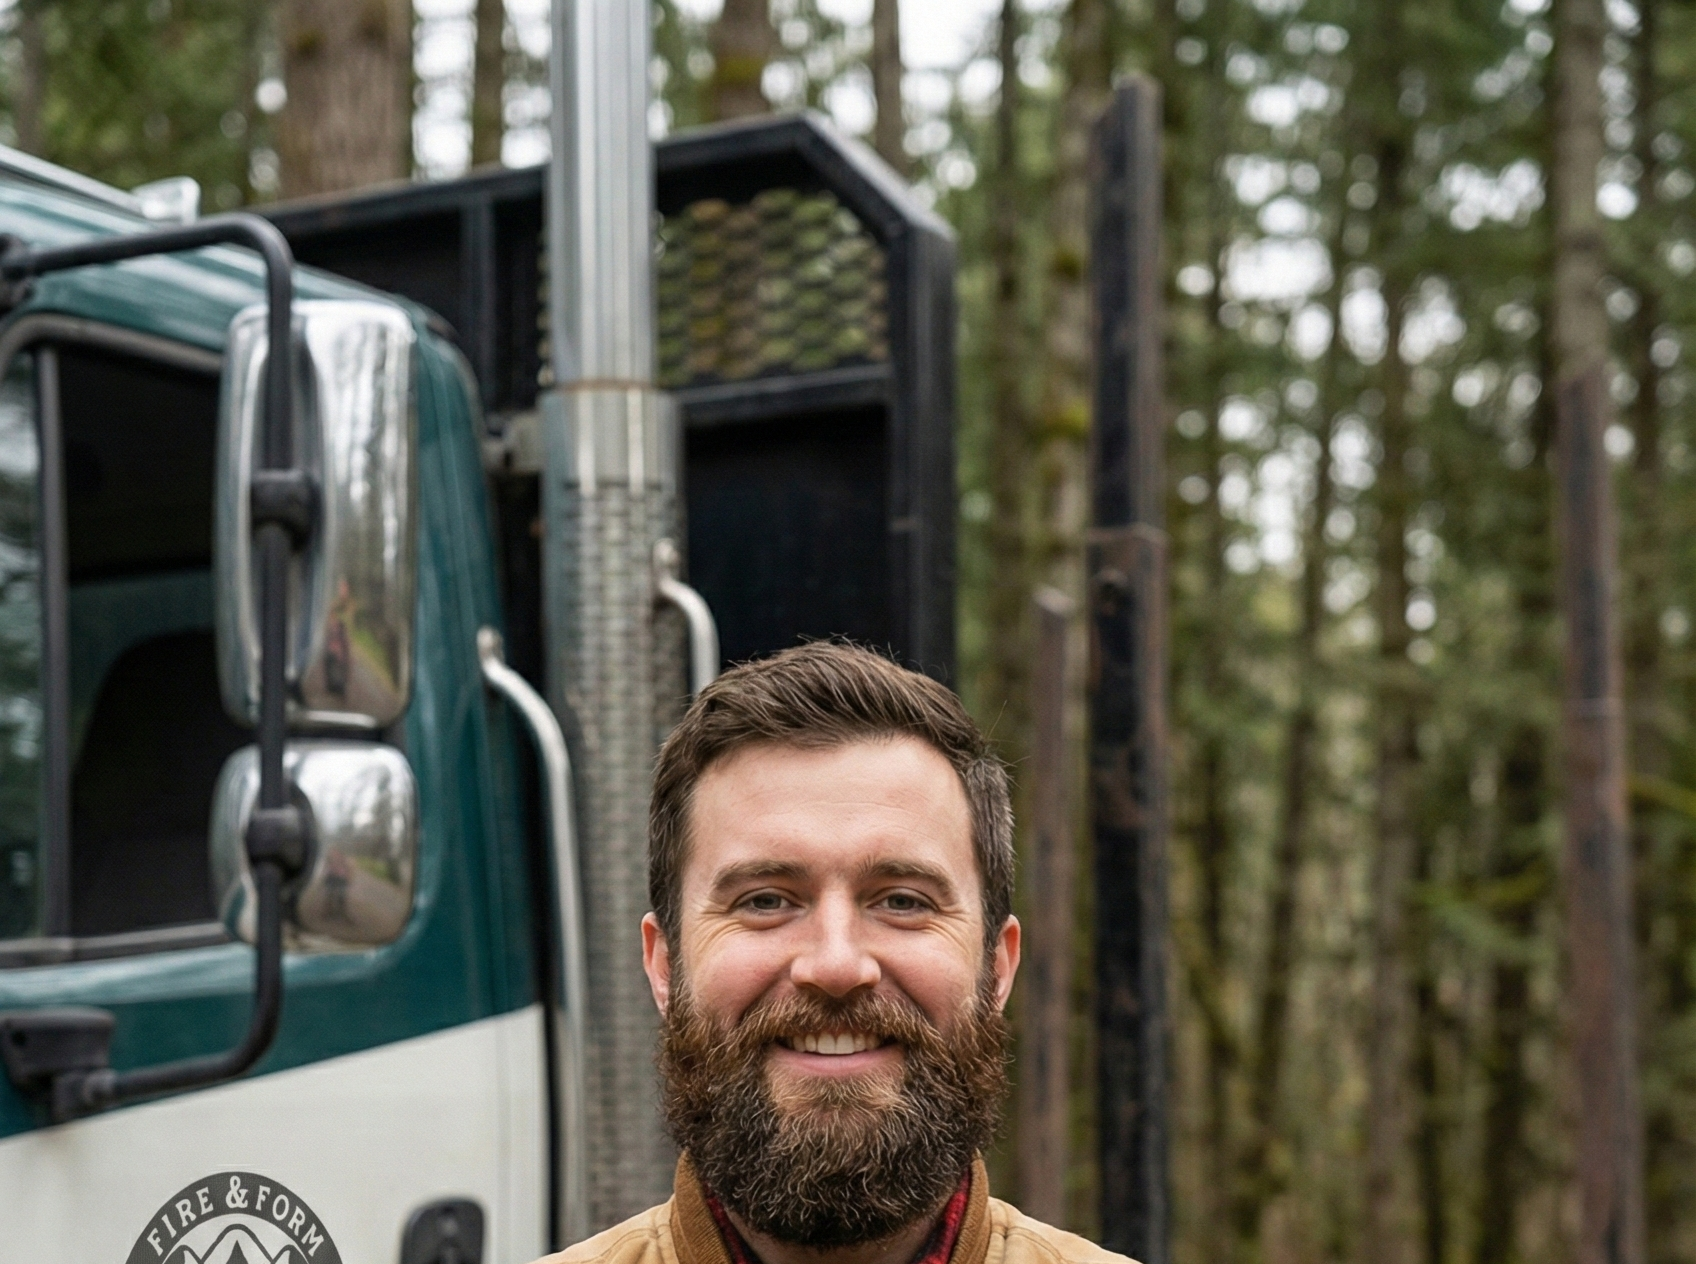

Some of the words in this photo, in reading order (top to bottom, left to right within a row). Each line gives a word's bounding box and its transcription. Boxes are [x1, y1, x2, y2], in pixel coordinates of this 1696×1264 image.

[147, 1186, 214, 1256] FIRE
[225, 1175, 248, 1209] &
[255, 1185, 324, 1256] FORM
